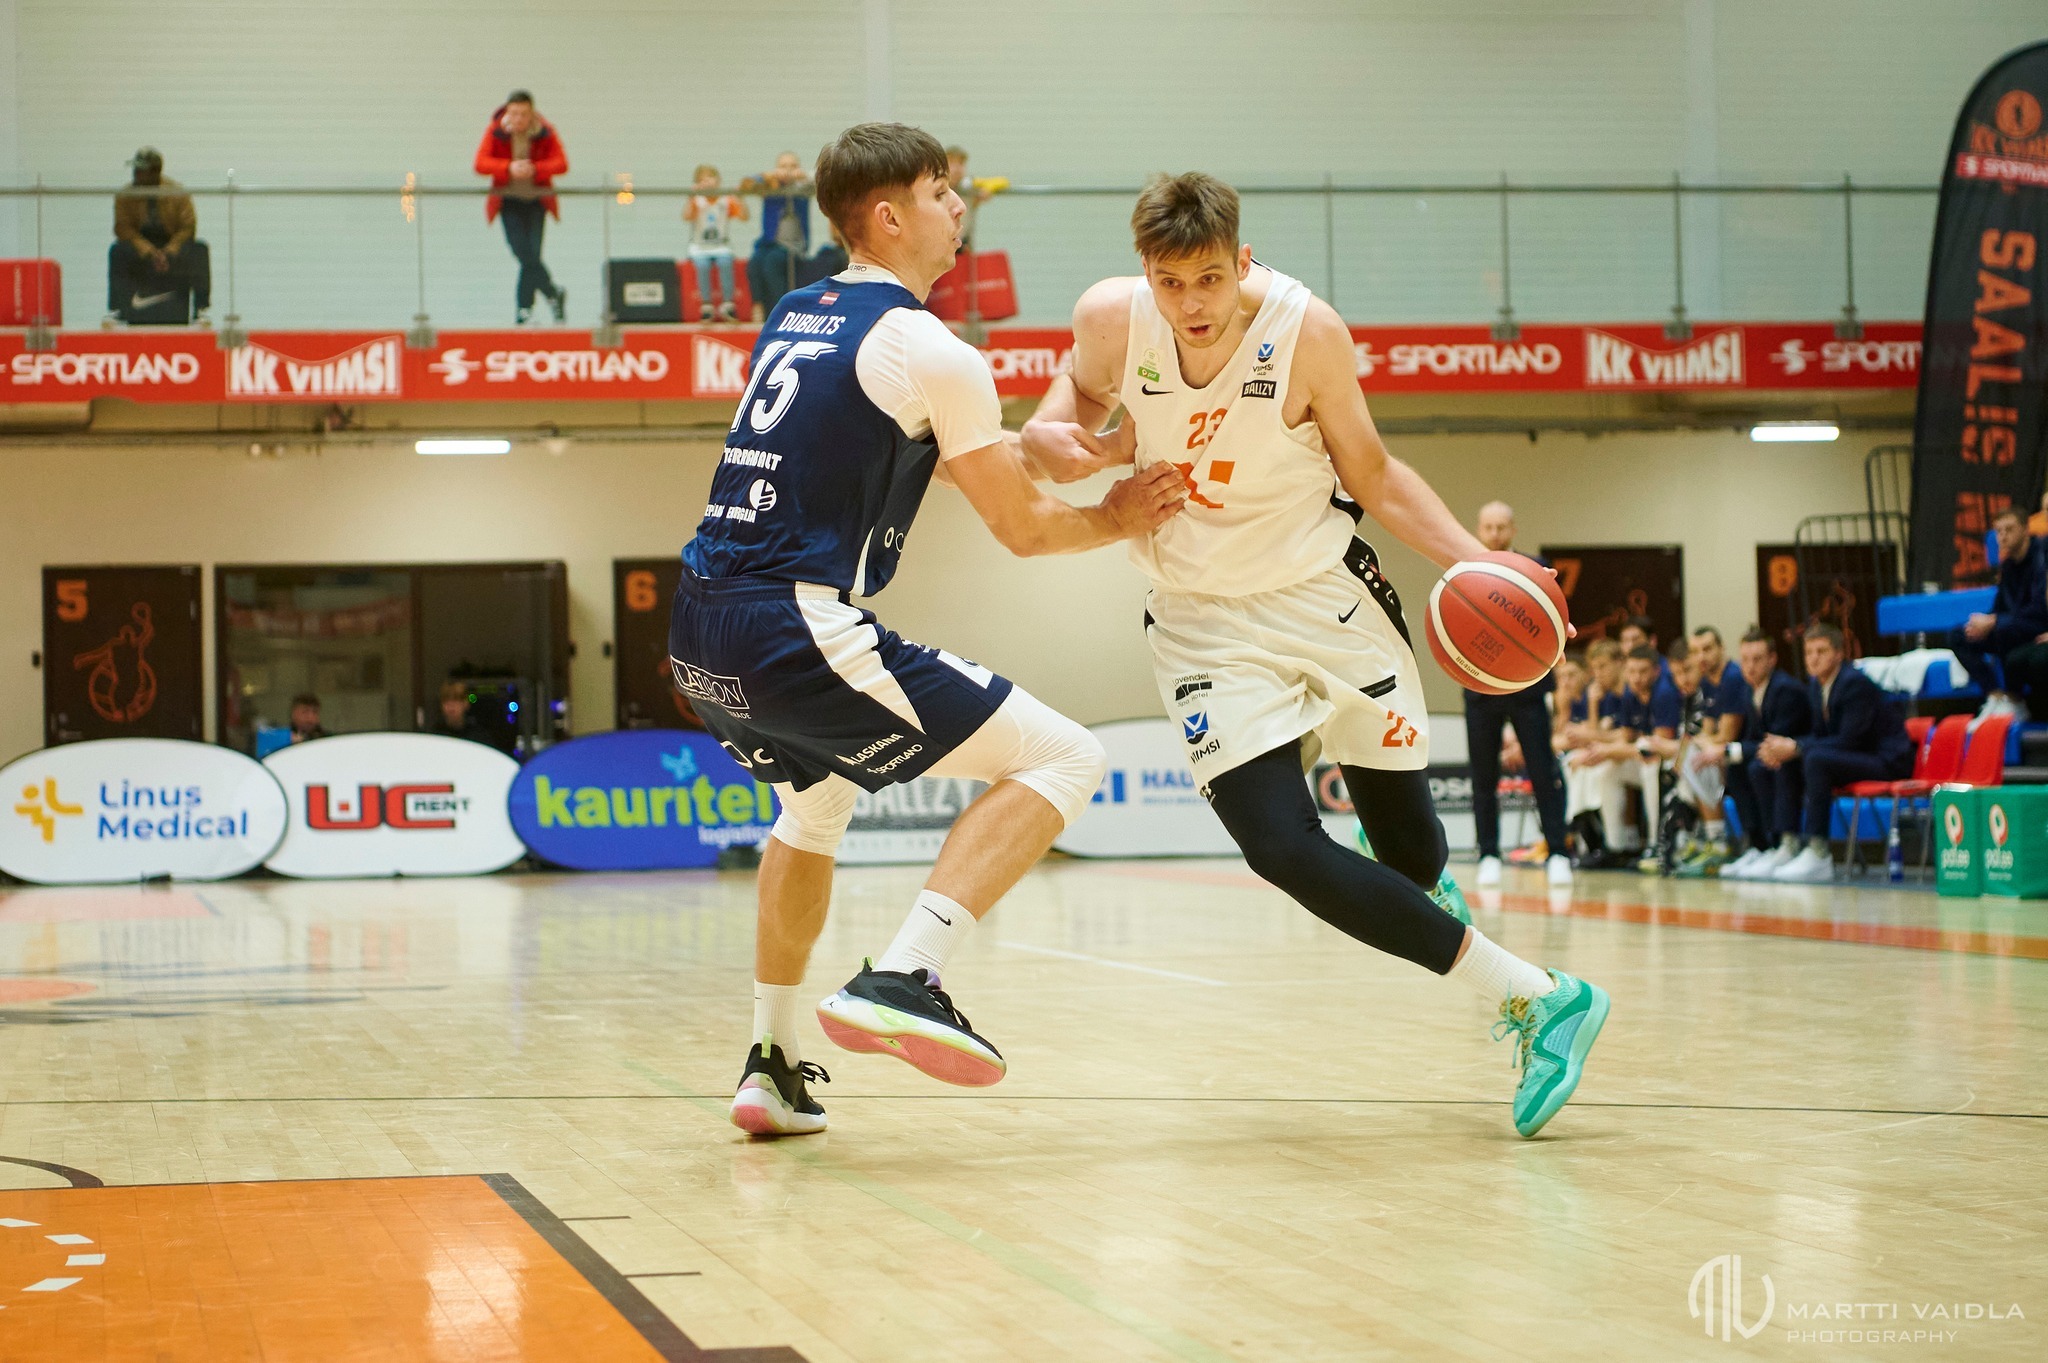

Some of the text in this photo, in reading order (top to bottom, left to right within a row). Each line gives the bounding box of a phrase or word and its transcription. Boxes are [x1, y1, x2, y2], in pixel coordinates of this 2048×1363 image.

[777, 311, 846, 335] DUBULTS
[11, 352, 200, 385] SPORTLAND
[230, 340, 397, 395] KK VIIMSI
[485, 350, 669, 383] SPORTLAND
[697, 339, 748, 393] KK
[1388, 343, 1562, 376] SPORTLAND
[1588, 331, 1742, 384] KK VIIMSI
[1821, 341, 1921, 372] SPORT
[730, 340, 838, 434] 15
[1243, 382, 1274, 396] BALLZY
[1187, 408, 1228, 450] 23
[625, 570, 656, 611] 6
[1769, 555, 1797, 597] 8
[57, 579, 87, 621] 5
[1488, 591, 1541, 638] molten
[1172, 672, 1209, 686] Lavendel
[875, 744, 923, 774] SPORTLAND
[100, 779, 201, 807] Linus
[305, 784, 455, 829] UC
[413, 798, 471, 812] RENT
[533, 774, 774, 828] kauritel
[98, 811, 248, 839] Medical
